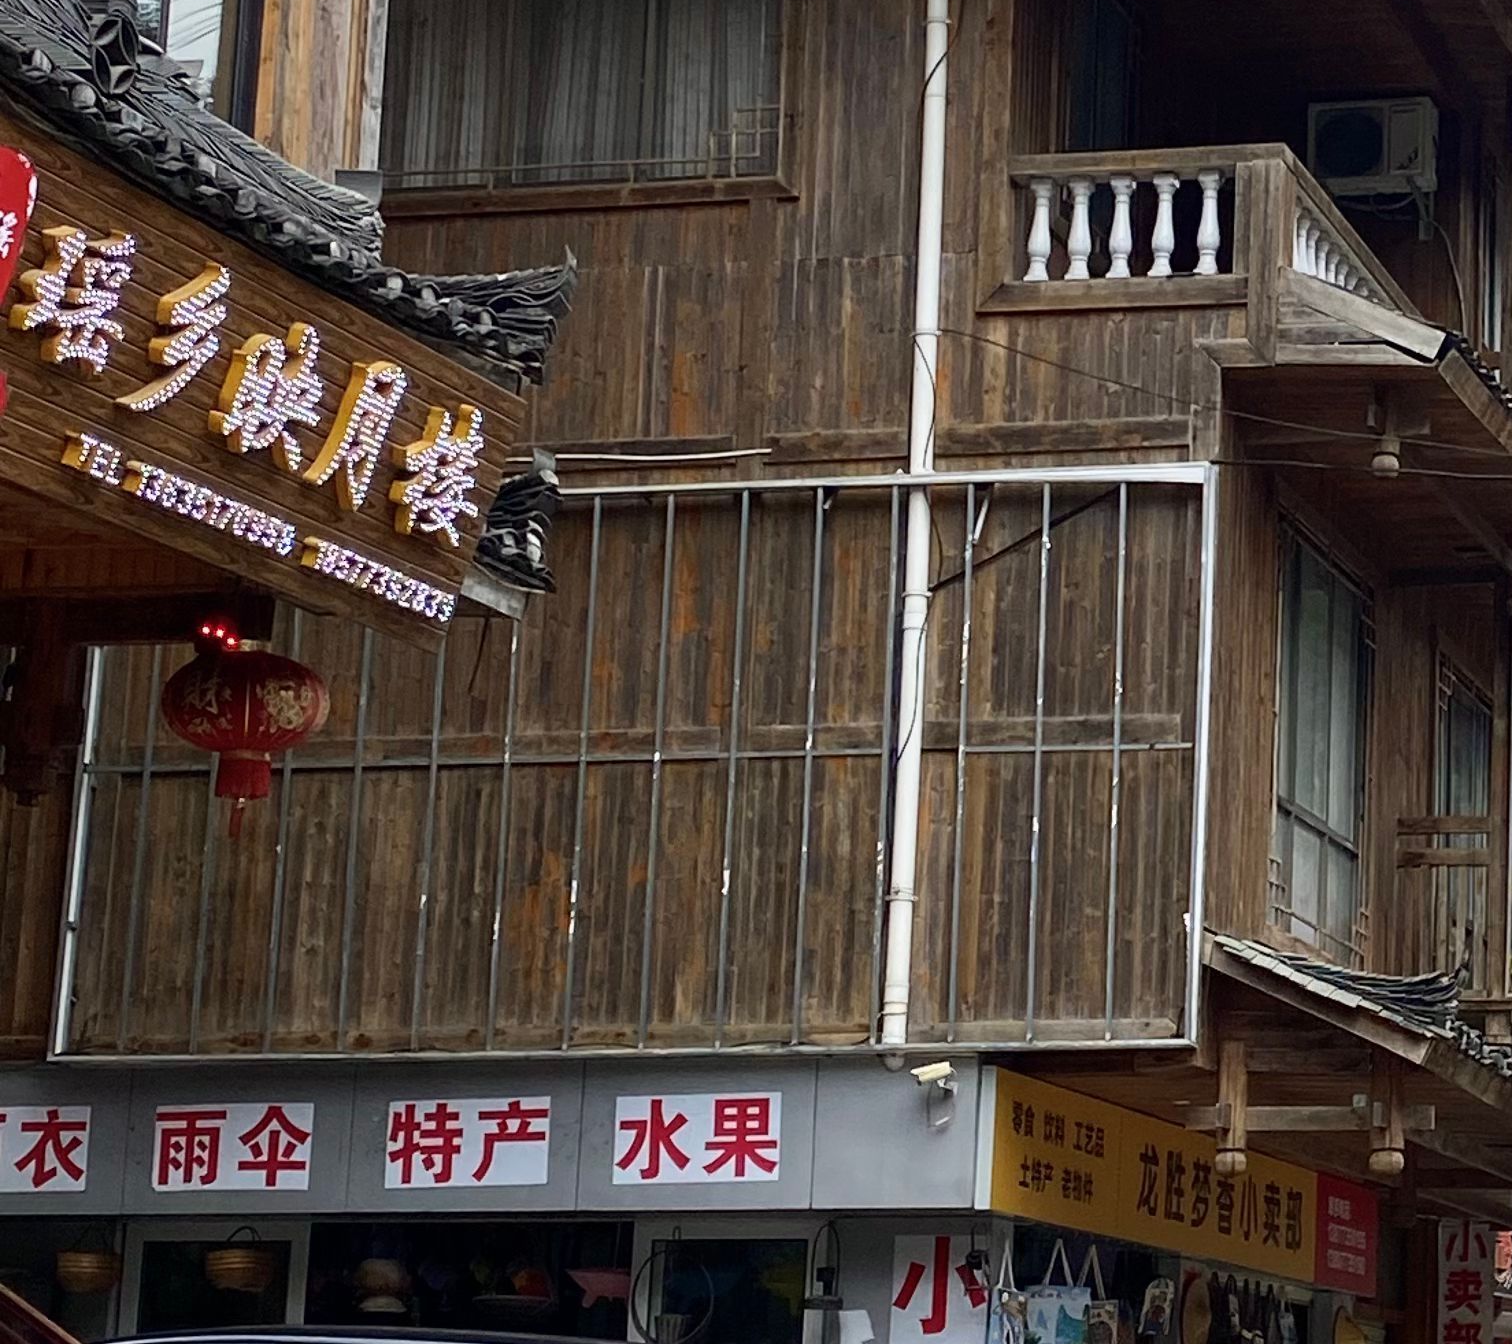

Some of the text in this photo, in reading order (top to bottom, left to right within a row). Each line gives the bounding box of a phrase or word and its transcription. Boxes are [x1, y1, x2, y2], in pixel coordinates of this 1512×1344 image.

[10, 226, 484, 548] 瑶乡映月楼
[0, 1108, 87, 1188] 衣
[155, 1104, 312, 1188] 雨伞
[388, 1100, 550, 1185] 特产
[616, 1097, 780, 1178] 水果
[1073, 1120, 1105, 1160] 工艺品
